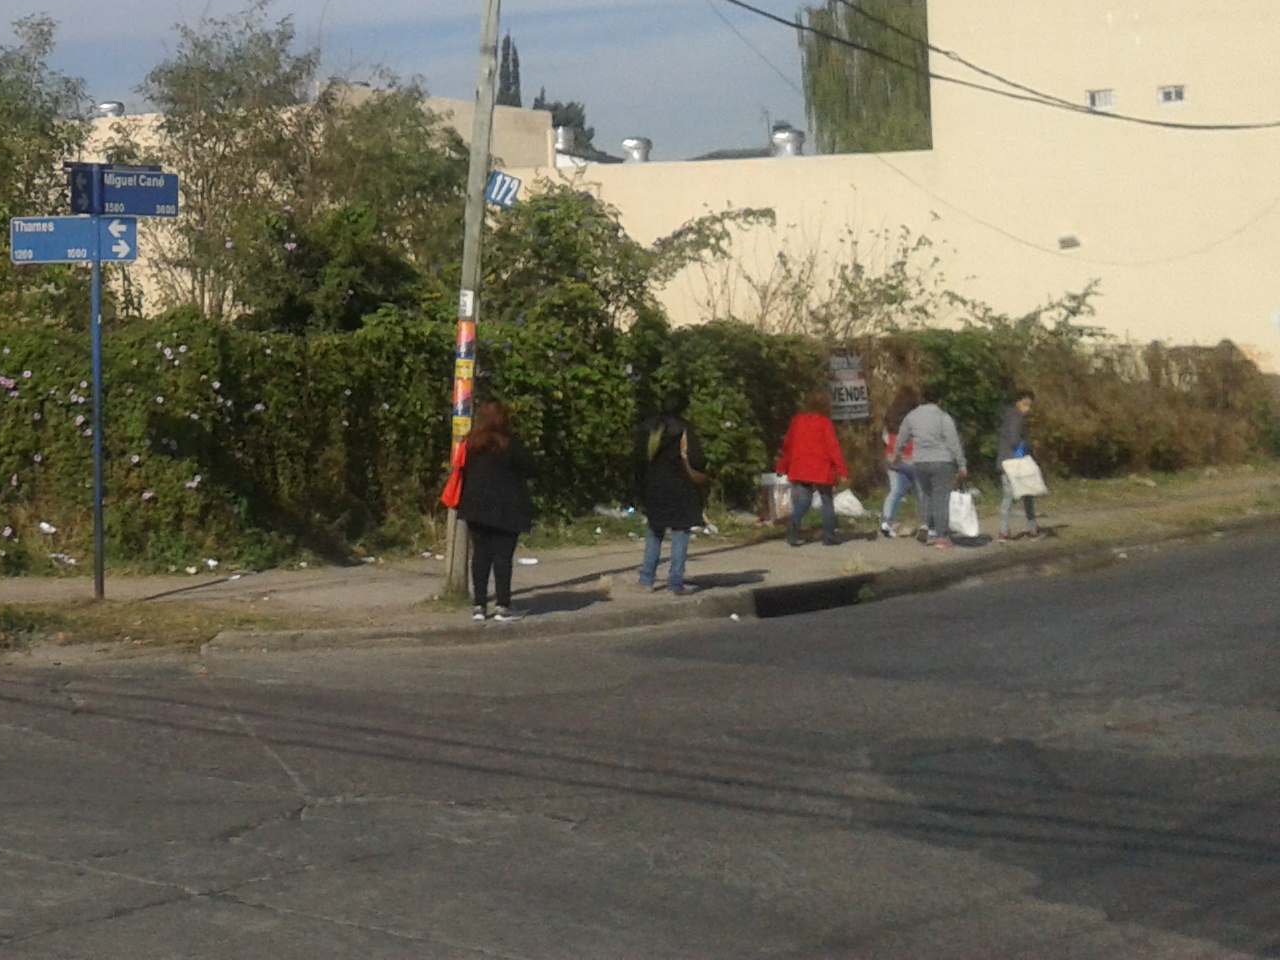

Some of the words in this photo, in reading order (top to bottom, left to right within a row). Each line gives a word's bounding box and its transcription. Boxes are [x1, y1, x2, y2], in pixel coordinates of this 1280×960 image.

[104, 173, 136, 188] Miguel
[138, 174, 165, 187] Cané
[491, 173, 519, 206] 172
[14, 220, 55, 232] Thames
[831, 385, 867, 402] VENDE
